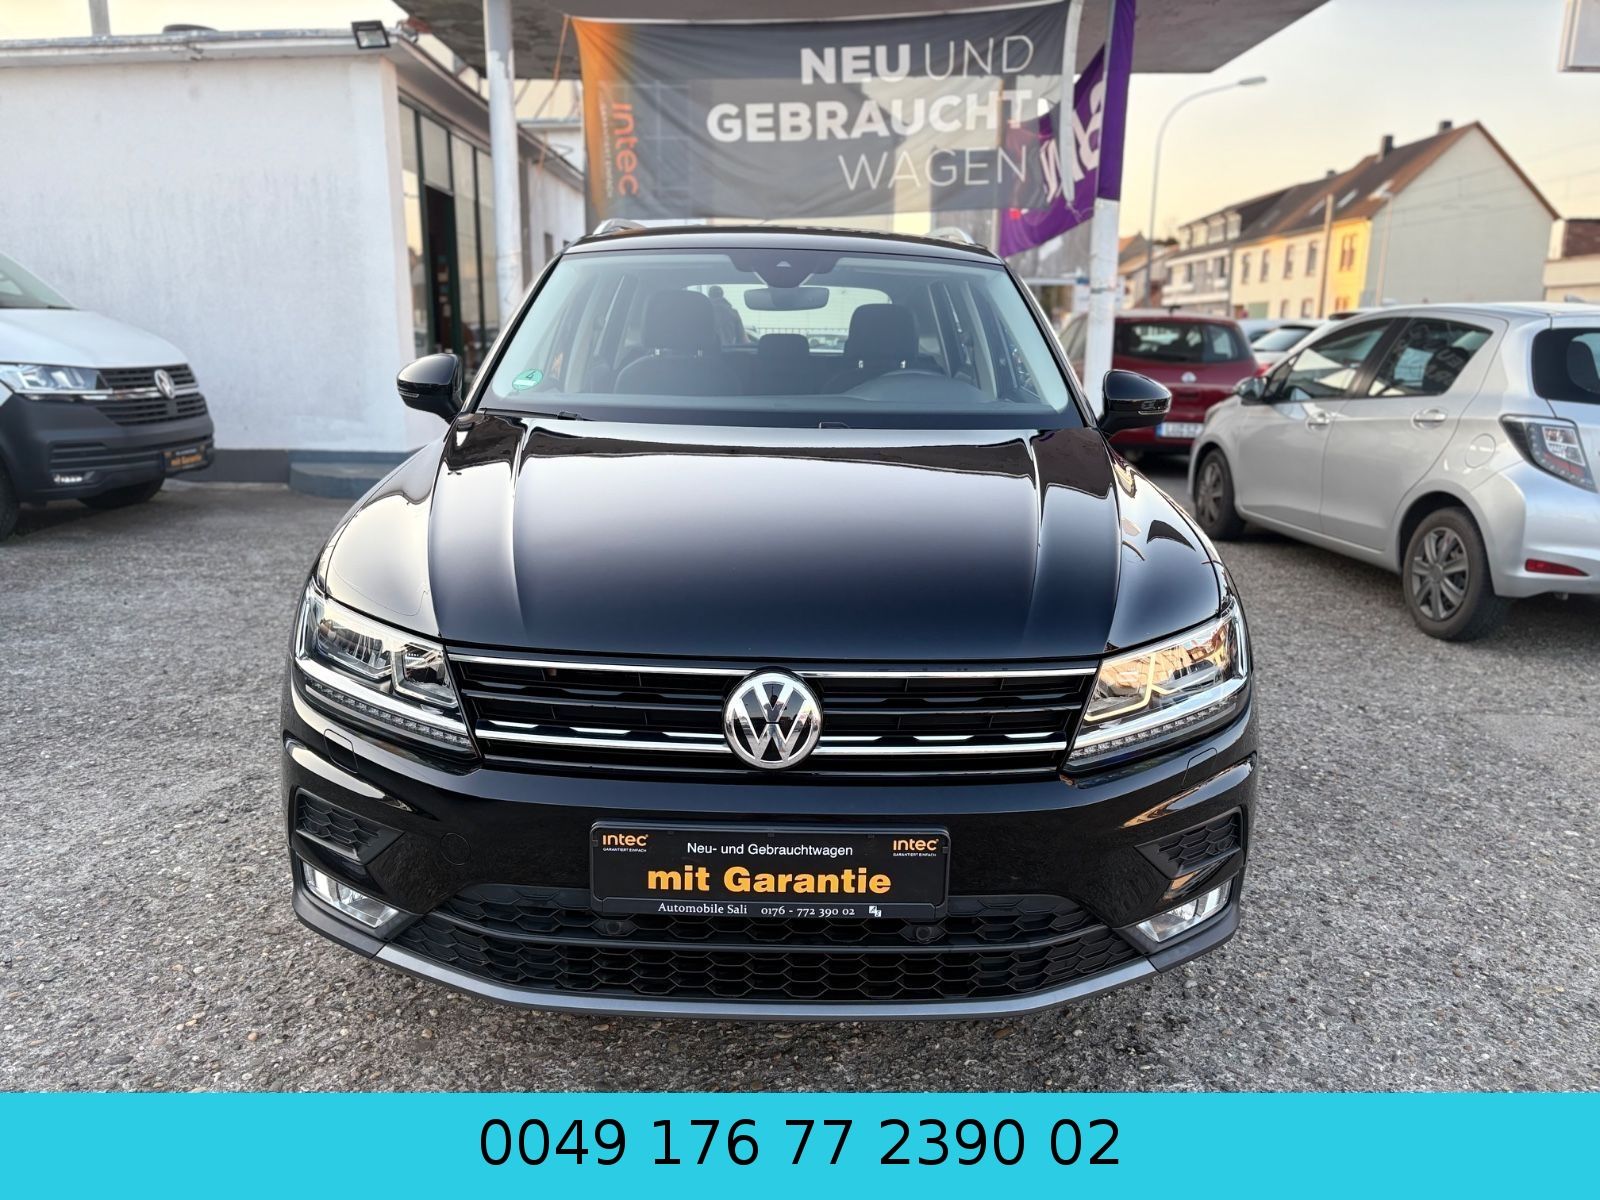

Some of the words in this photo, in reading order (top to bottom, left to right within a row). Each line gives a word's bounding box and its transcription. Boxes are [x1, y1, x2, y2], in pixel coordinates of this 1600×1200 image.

[800, 44, 911, 85] NEU
[925, 35, 1034, 82] UND
[706, 89, 1032, 142] GEBRAUCHT
[612, 103, 639, 196] intec
[838, 148, 1027, 190] WAGEN
[728, 674, 818, 767] VW
[602, 834, 647, 847] intec
[687, 842, 717, 855] Neu-
[721, 843, 744, 855] und
[748, 843, 853, 858] Gebrauchtwagen
[893, 838, 937, 851] intec
[647, 865, 710, 891] mit
[723, 866, 892, 894] Garantie
[658, 902, 724, 914] Automobile
[727, 903, 747, 914] Sali
[761, 905, 786, 917] 0176
[797, 907, 815, 917] 772
[818, 907, 839, 917] 390
[842, 908, 855, 916] 02
